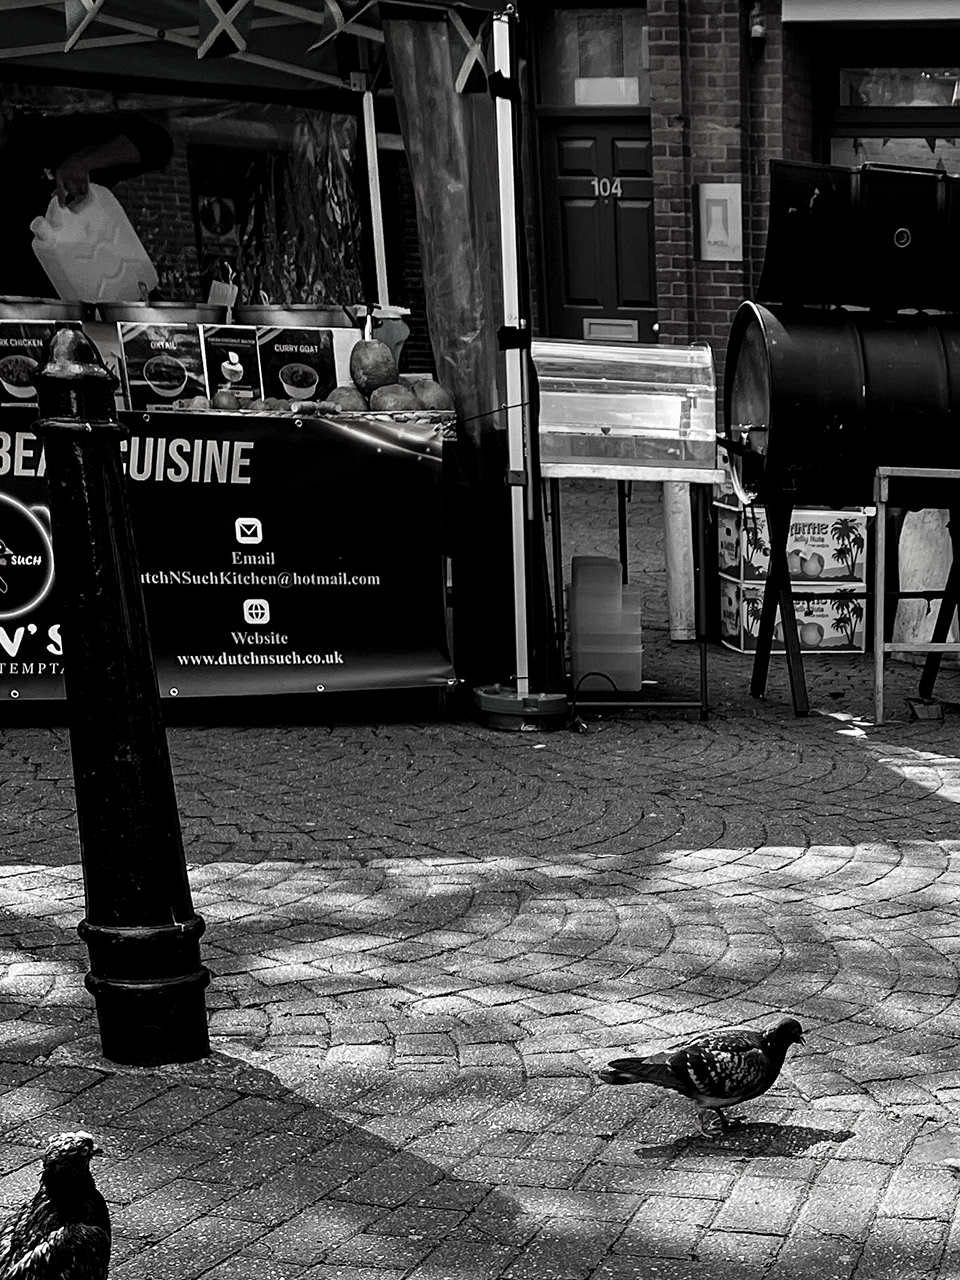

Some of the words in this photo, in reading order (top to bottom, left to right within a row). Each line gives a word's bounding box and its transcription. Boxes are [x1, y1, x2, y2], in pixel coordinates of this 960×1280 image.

[591, 178, 622, 197] 104
[151, 341, 177, 349] OXTAIL
[274, 344, 298, 353] CURRY
[299, 345, 319, 353] GOAT
[11, 556, 42, 566] SUCH
[231, 551, 276, 566] Email
[231, 630, 289, 645] Website
[177, 650, 344, 666] www.dutchnsuch.co.uk
